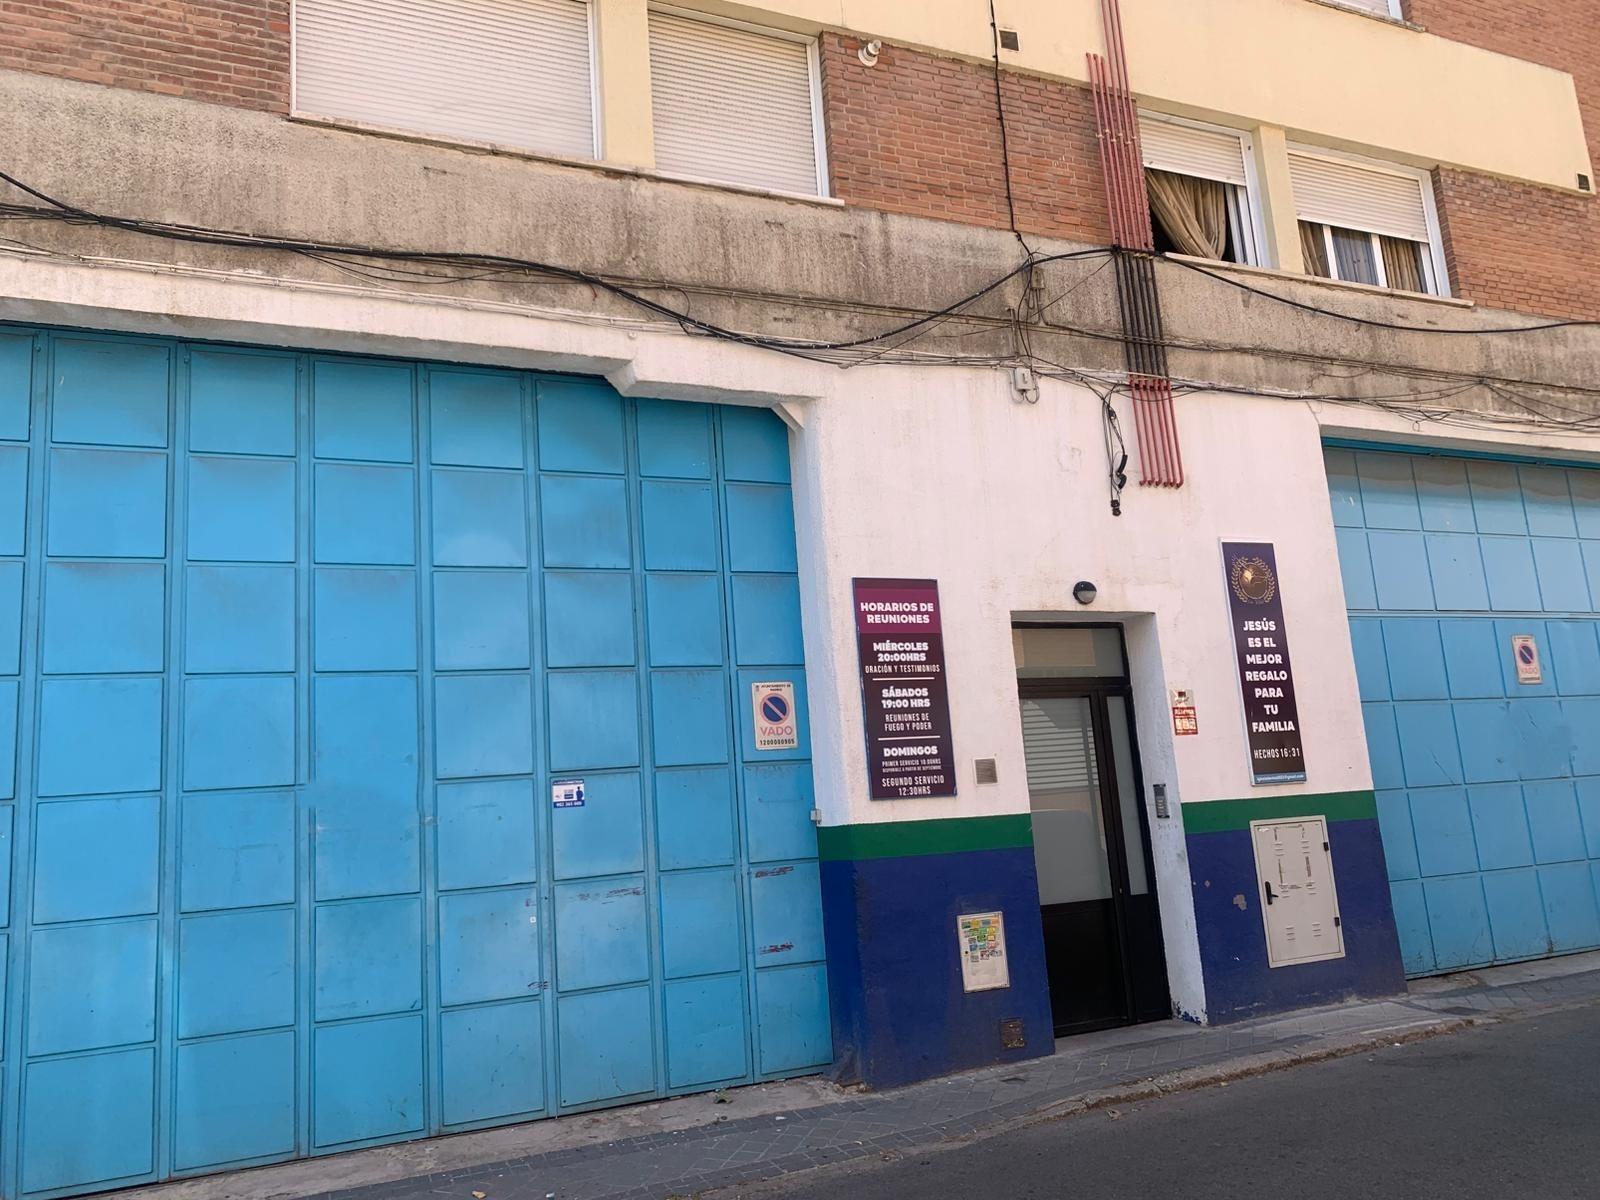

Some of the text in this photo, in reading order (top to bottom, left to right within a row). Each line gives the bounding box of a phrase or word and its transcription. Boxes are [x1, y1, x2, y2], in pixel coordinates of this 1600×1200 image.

[860, 602, 934, 612] HORARIOS DE
[866, 614, 930, 624] REUNIONES
[1243, 617, 1276, 631] JESÚS
[872, 640, 929, 652] MIÉRCOLES
[1247, 637, 1277, 648] ES EL
[877, 652, 927, 662] 20:00HRS
[1246, 654, 1283, 664] MEJOR
[865, 664, 940, 674] ORACIÓN Y TESTIMONIOS
[1245, 671, 1288, 681] REGALO
[882, 686, 929, 697] SÁBADOS
[1254, 687, 1284, 698] PARA
[882, 698, 931, 708] 19:00 HRS
[1263, 704, 1279, 715] TU
[885, 713, 930, 722] REUNIONES DE
[760, 725, 793, 736] VADO
[884, 723, 905, 731] FUEGO
[912, 722, 932, 730] PODER
[1252, 721, 1295, 733] FAMILIA
[883, 746, 938, 757] DOMINGOS
[1253, 747, 1300, 759] HECHOS 16:31
[882, 775, 945, 787] SEGUNDO SERVICIO
[898, 786, 931, 796] 12:30HRS
